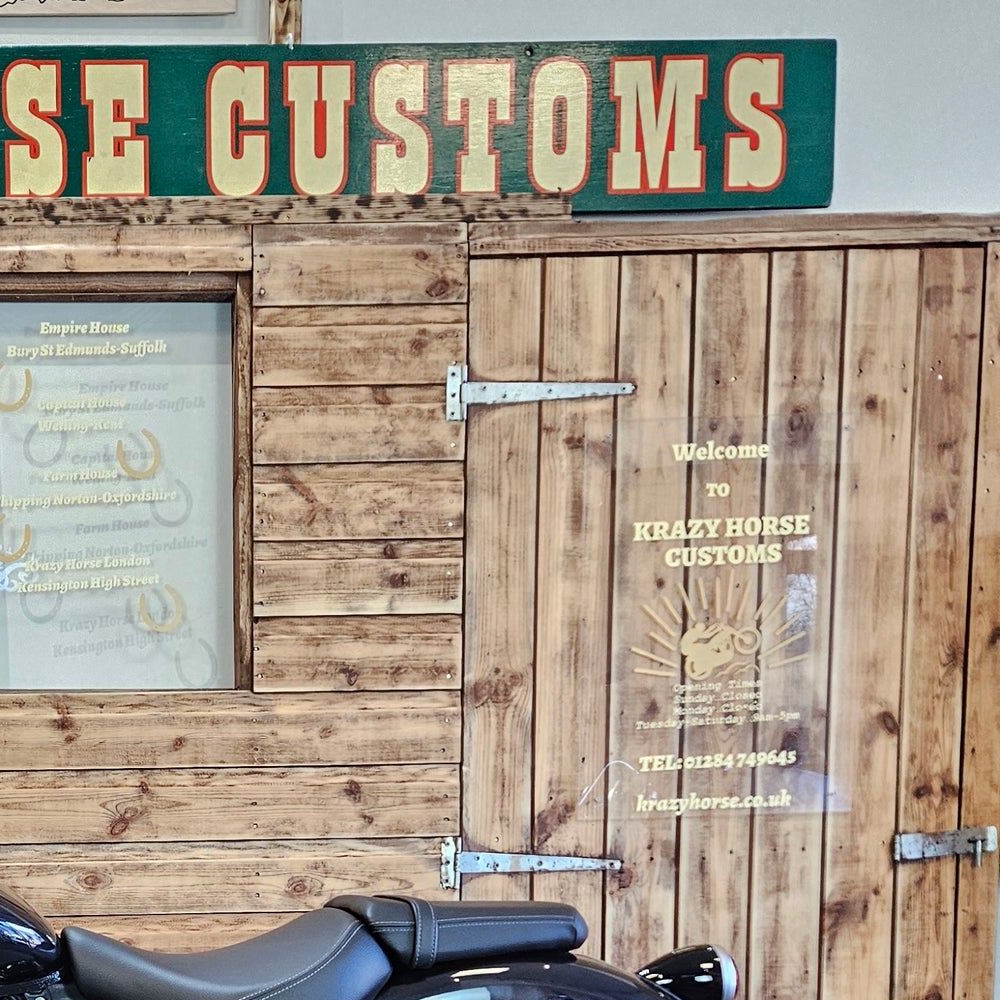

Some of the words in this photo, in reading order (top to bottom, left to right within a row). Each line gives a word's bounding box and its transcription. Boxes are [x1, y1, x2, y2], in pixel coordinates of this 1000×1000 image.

[206, 53, 787, 198] CUSTOMS
[40, 320, 88, 338] Empire
[88, 320, 131, 335] House
[6, 345, 38, 360] Bury
[39, 343, 54, 356] St
[55, 339, 168, 358] Edmunds-Suffolk
[672, 443, 769, 462] Welcome
[43, 469, 78, 482] Farm
[78, 468, 118, 481] House
[53, 489, 177, 507] Norton-Oxfordshire
[705, 482, 731, 498] TO
[632, 518, 722, 542] KRAZY
[724, 514, 811, 539] HORSE
[24, 559, 63, 574] Krazy
[65, 558, 102, 571] Horse
[103, 554, 151, 569] London
[664, 542, 783, 568] CUSTOMS
[17, 578, 88, 594] Kensington
[90, 575, 121, 591] High
[122, 573, 160, 586] Street
[672, 682, 722, 694] Opening
[728, 679, 763, 689] Times
[672, 693, 715, 706] Sunday
[721, 691, 763, 701] Closed
[636, 789, 792, 813] krazyhorse.co.uk
